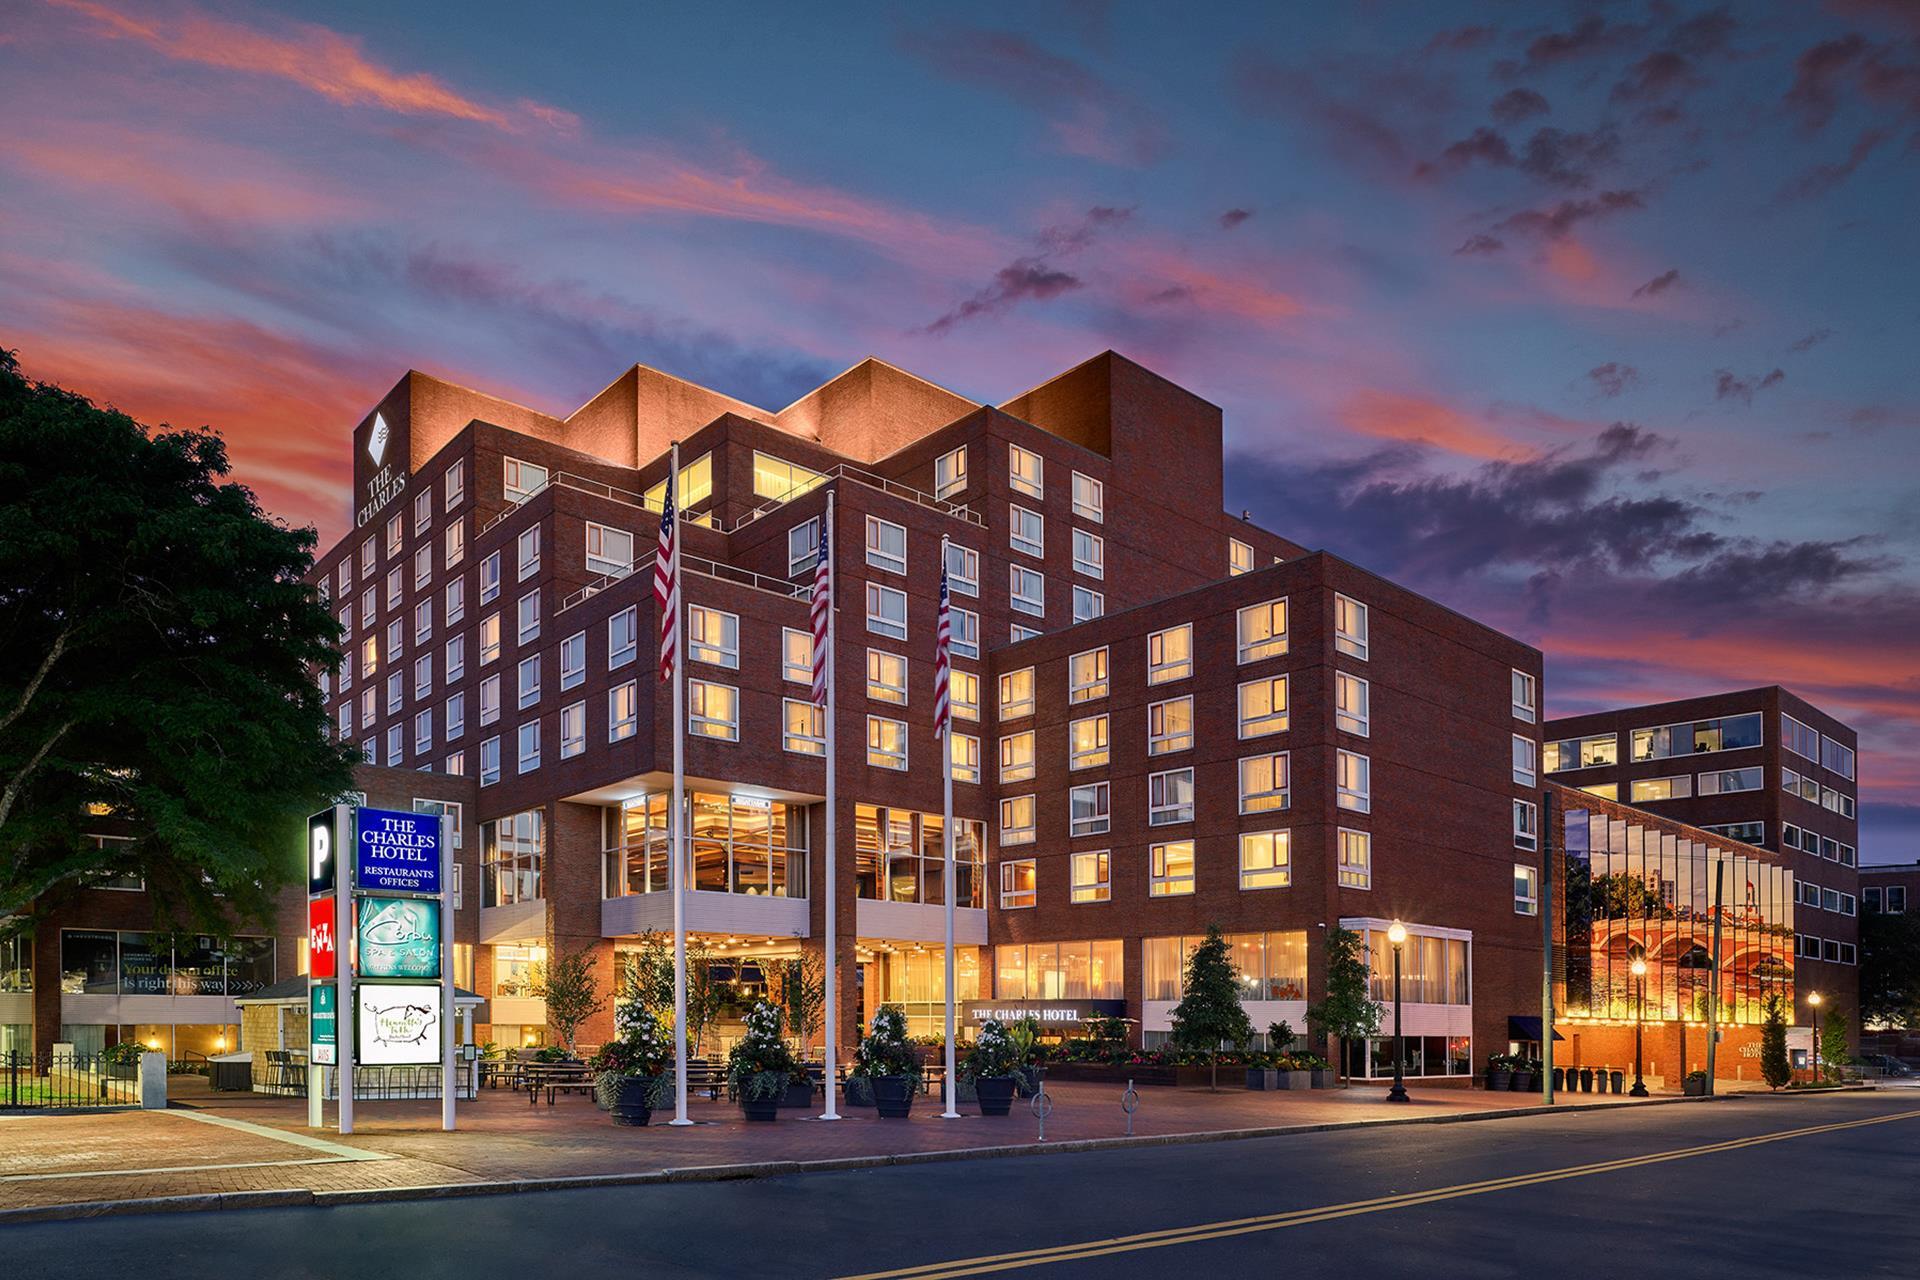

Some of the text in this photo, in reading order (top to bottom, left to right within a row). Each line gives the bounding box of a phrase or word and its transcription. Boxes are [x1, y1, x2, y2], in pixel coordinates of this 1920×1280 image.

[367, 463, 392, 499] THE
[357, 471, 406, 528] CHARLES
[381, 818, 417, 833] THE
[361, 830, 435, 849] CHARLES
[313, 825, 329, 880] P
[371, 845, 427, 862] HOTEL
[364, 866, 434, 879] RESTAURANTS
[379, 877, 420, 888] OFFICES
[124, 963, 157, 976] Your
[203, 965, 238, 977] office
[124, 976, 135, 989] is
[138, 976, 171, 992] right
[200, 980, 225, 992] way
[972, 1009, 993, 1019] THE
[1043, 1009, 1079, 1021] HOTEL
